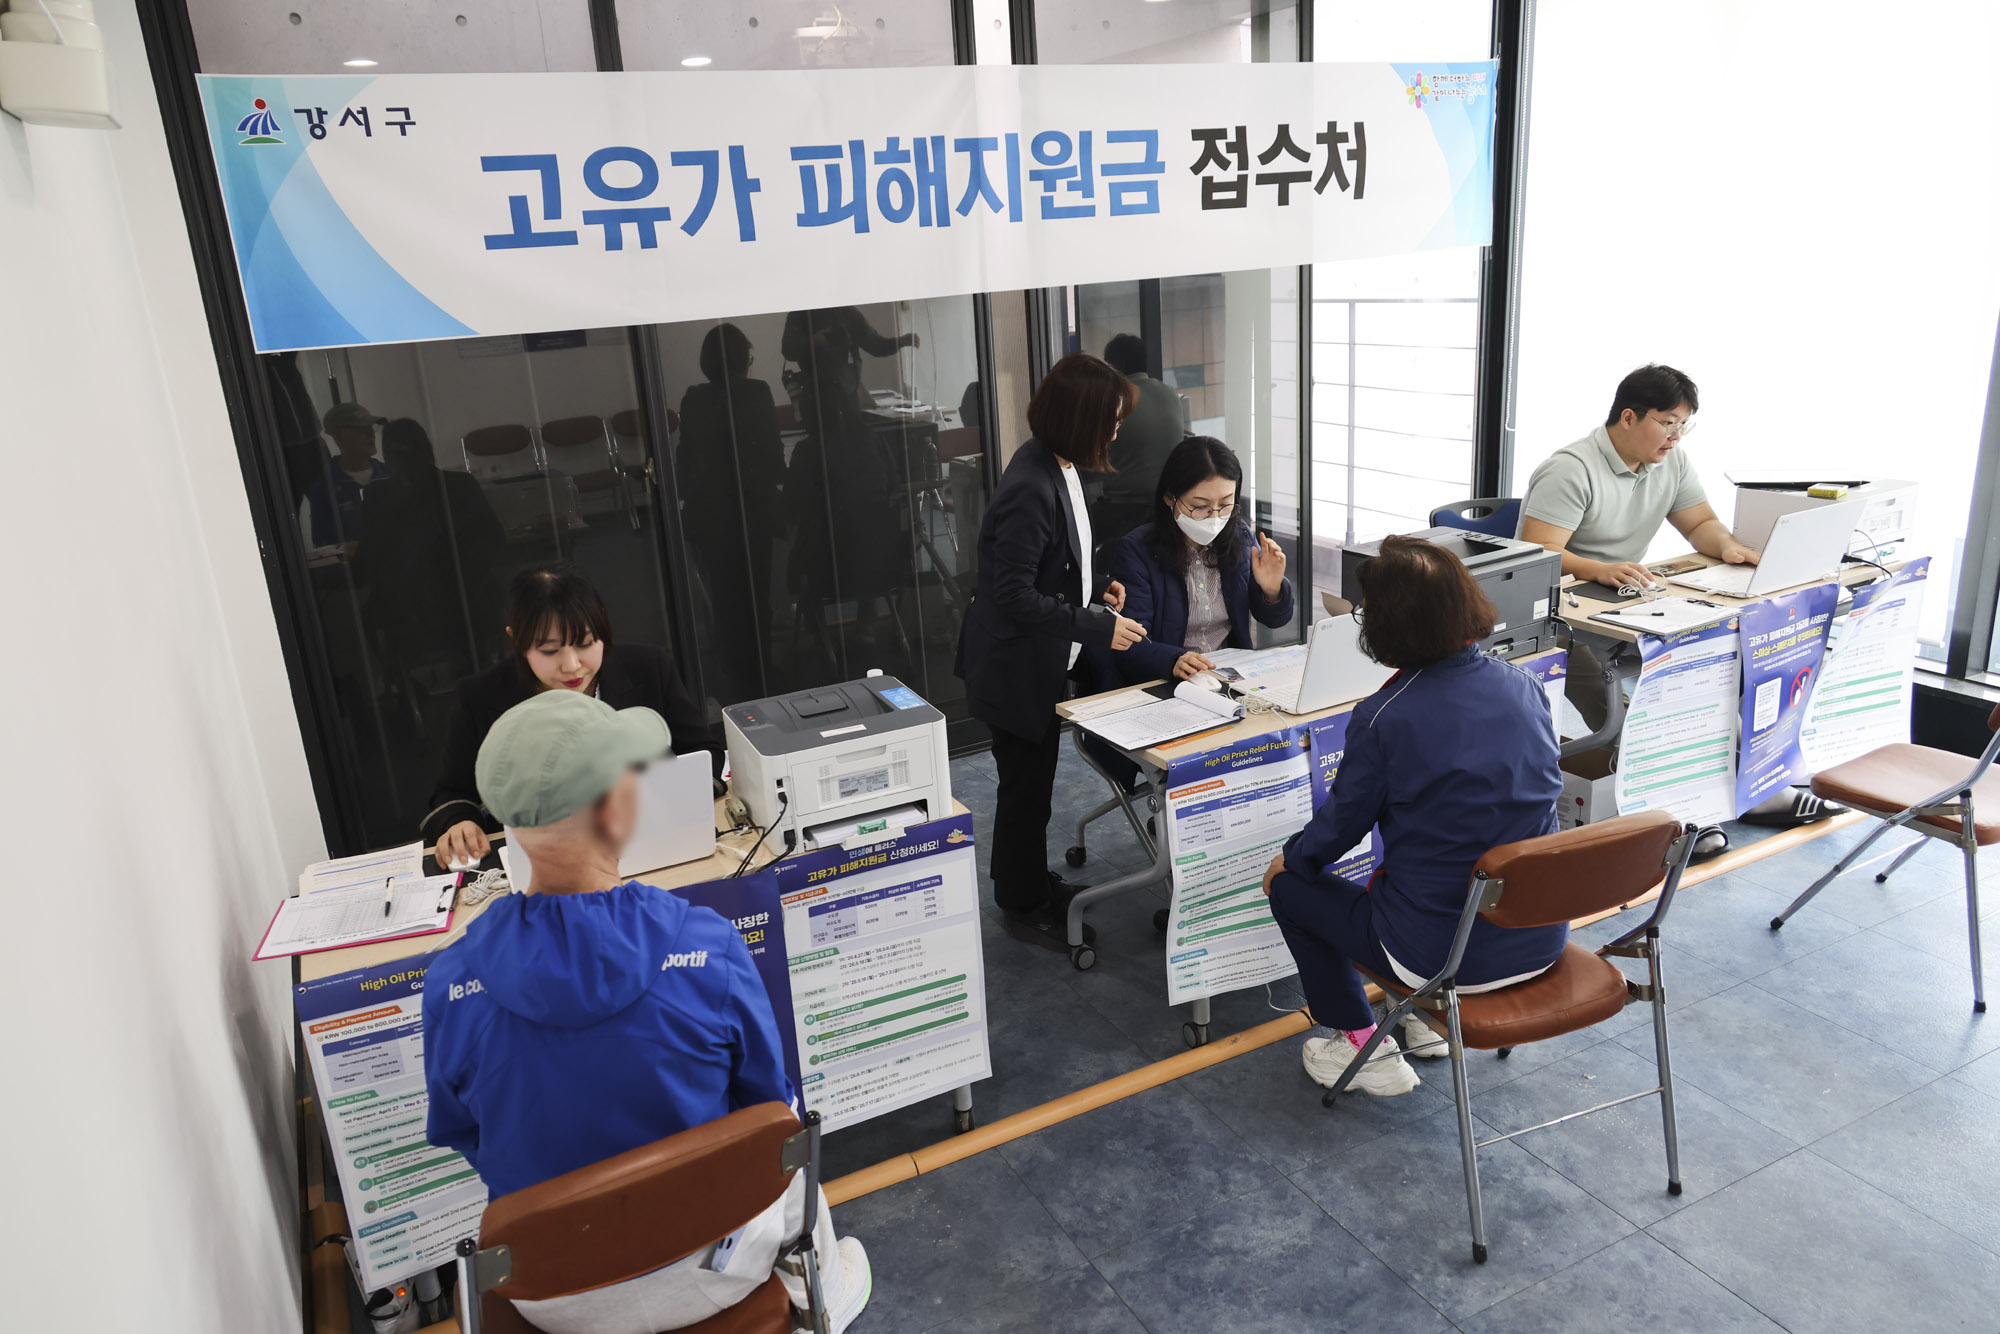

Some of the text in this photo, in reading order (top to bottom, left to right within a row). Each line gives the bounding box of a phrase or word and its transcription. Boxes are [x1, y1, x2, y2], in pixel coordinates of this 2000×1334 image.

[294, 106, 416, 140] 강서구
[480, 120, 1368, 252] 고유가 피해지원금 접수처
[1749, 633, 1768, 647] 고유가
[1205, 756, 1220, 768] High
[1221, 753, 1230, 762] Oil
[1231, 750, 1248, 760] Price
[1249, 743, 1268, 754] Relief
[1270, 738, 1291, 750] Funds
[1232, 754, 1263, 768] Guidelines
[1319, 750, 1344, 768] 고유가
[808, 838, 939, 882] 고유가 피해지원금 신청하세요!
[732, 912, 769, 930] 사칭한
[661, 950, 708, 971] portif
[360, 977, 387, 992] High
[388, 972, 406, 984] Oil
[449, 979, 488, 1001] le co
[324, 1032, 339, 1040] KRW
[341, 1026, 366, 1036] 100,000
